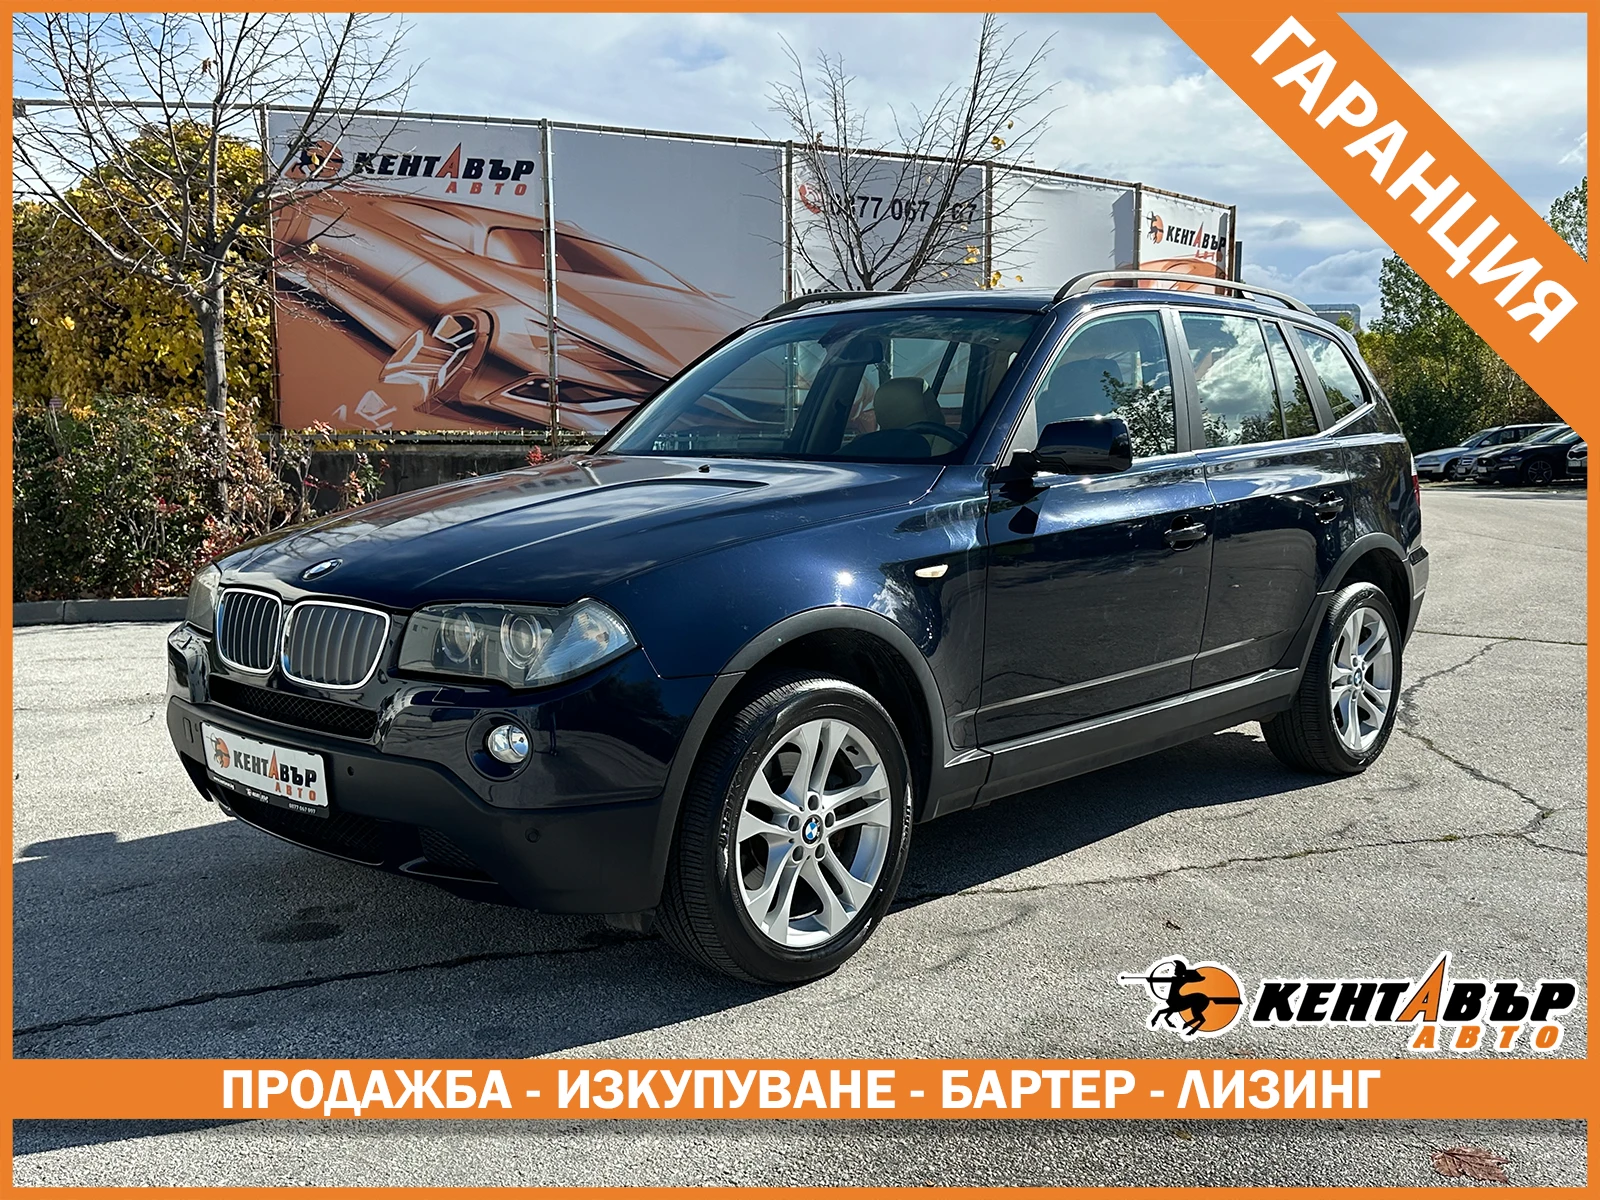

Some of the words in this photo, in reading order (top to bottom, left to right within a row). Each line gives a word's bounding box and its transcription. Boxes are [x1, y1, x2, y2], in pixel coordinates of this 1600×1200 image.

[353, 142, 534, 181] КЕНТАВЪР
[445, 181, 527, 195] АВТО
[890, 198, 930, 222] 067
[1166, 221, 1227, 251] КЕНТАВЪР
[233, 748, 317, 787] КЕНТАВЪР
[275, 781, 316, 801] АВТО
